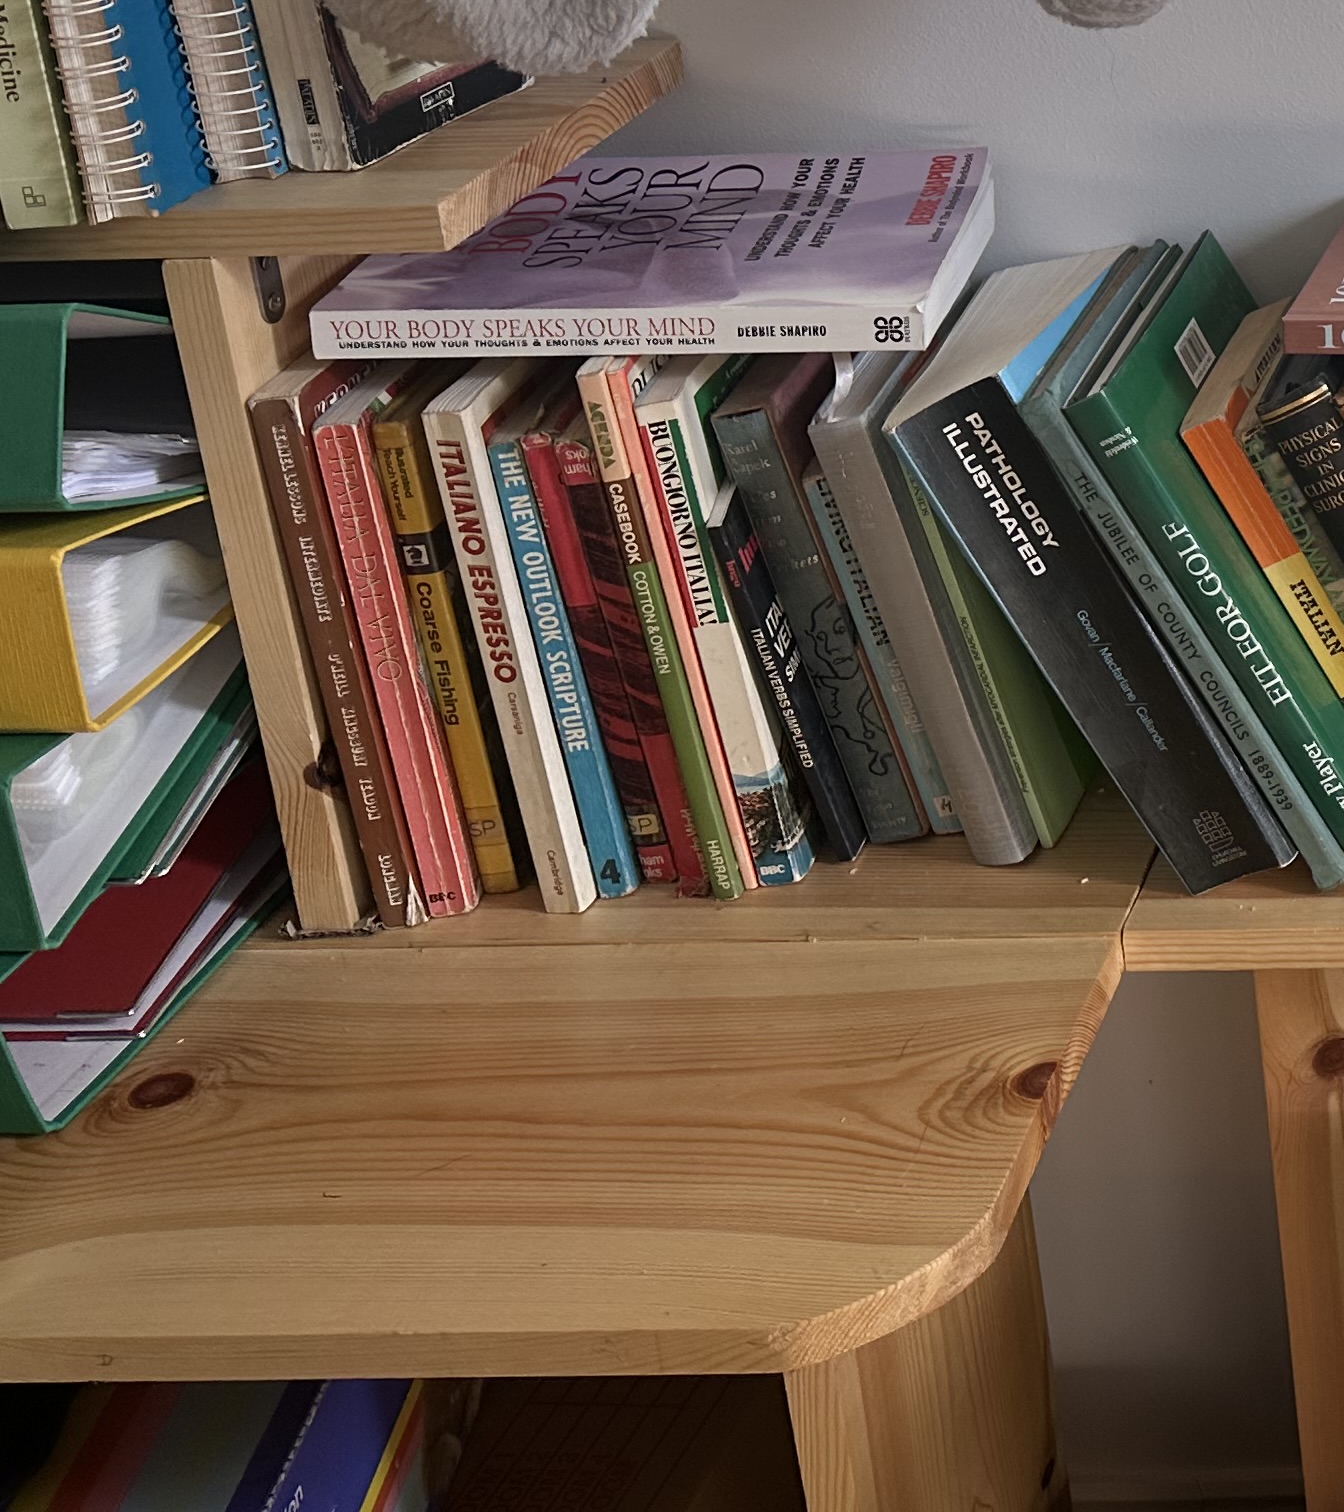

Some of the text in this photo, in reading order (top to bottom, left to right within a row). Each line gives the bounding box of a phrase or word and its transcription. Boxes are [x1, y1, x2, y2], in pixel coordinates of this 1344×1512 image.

[522, 167, 643, 268] SPEAKS
[600, 162, 710, 252] YOUR
[663, 164, 764, 251] MIND
[774, 158, 840, 258] THOUGHTS EMOTIONS
[791, 158, 815, 188] YOUR
[808, 157, 865, 248] AFFECT HEALTH
[330, 317, 827, 339] YOUR BODY SPEAKS YOUR MIND DEBBIE SHAPIRO
[338, 337, 716, 349] UNDERSTAND HOW YOUR THOUGHTS EMOTIONS AFFECT YOUR HEALTH
[498, 449, 525, 487] THE
[965, 412, 1061, 549] PATHOLOGY
[1278, 417, 1344, 455] PHYSICAL
[1295, 437, 1343, 468] SIGNS
[1318, 460, 1336, 476] IN
[508, 495, 539, 544] NEW
[609, 483, 641, 565] CASEBOOK
[647, 419, 698, 550] BUONGIORNO
[684, 552, 718, 627] ITALIA!
[942, 422, 1047, 578] ILLUSTRATED
[436, 439, 518, 683] ITALIANO ESPRESSO
[522, 552, 563, 645] OUTLOOK
[416, 581, 459, 726] Coarse Fishing
[632, 570, 671, 676] COTTON OWEN
[1074, 473, 1293, 812] THE JUBILEE OF COUNTY COUNCILS 1889-1939
[1162, 522, 1292, 709] FIT FOR GOLF
[547, 651, 589, 753] SCRIPTURE
[750, 628, 778, 671] ITALIAN
[766, 669, 791, 708] VERBS
[781, 705, 815, 769] SIMPLIFIED
[468, 820, 496, 837] SP
[600, 859, 621, 884] 4
[706, 839, 732, 890] HARRAP
